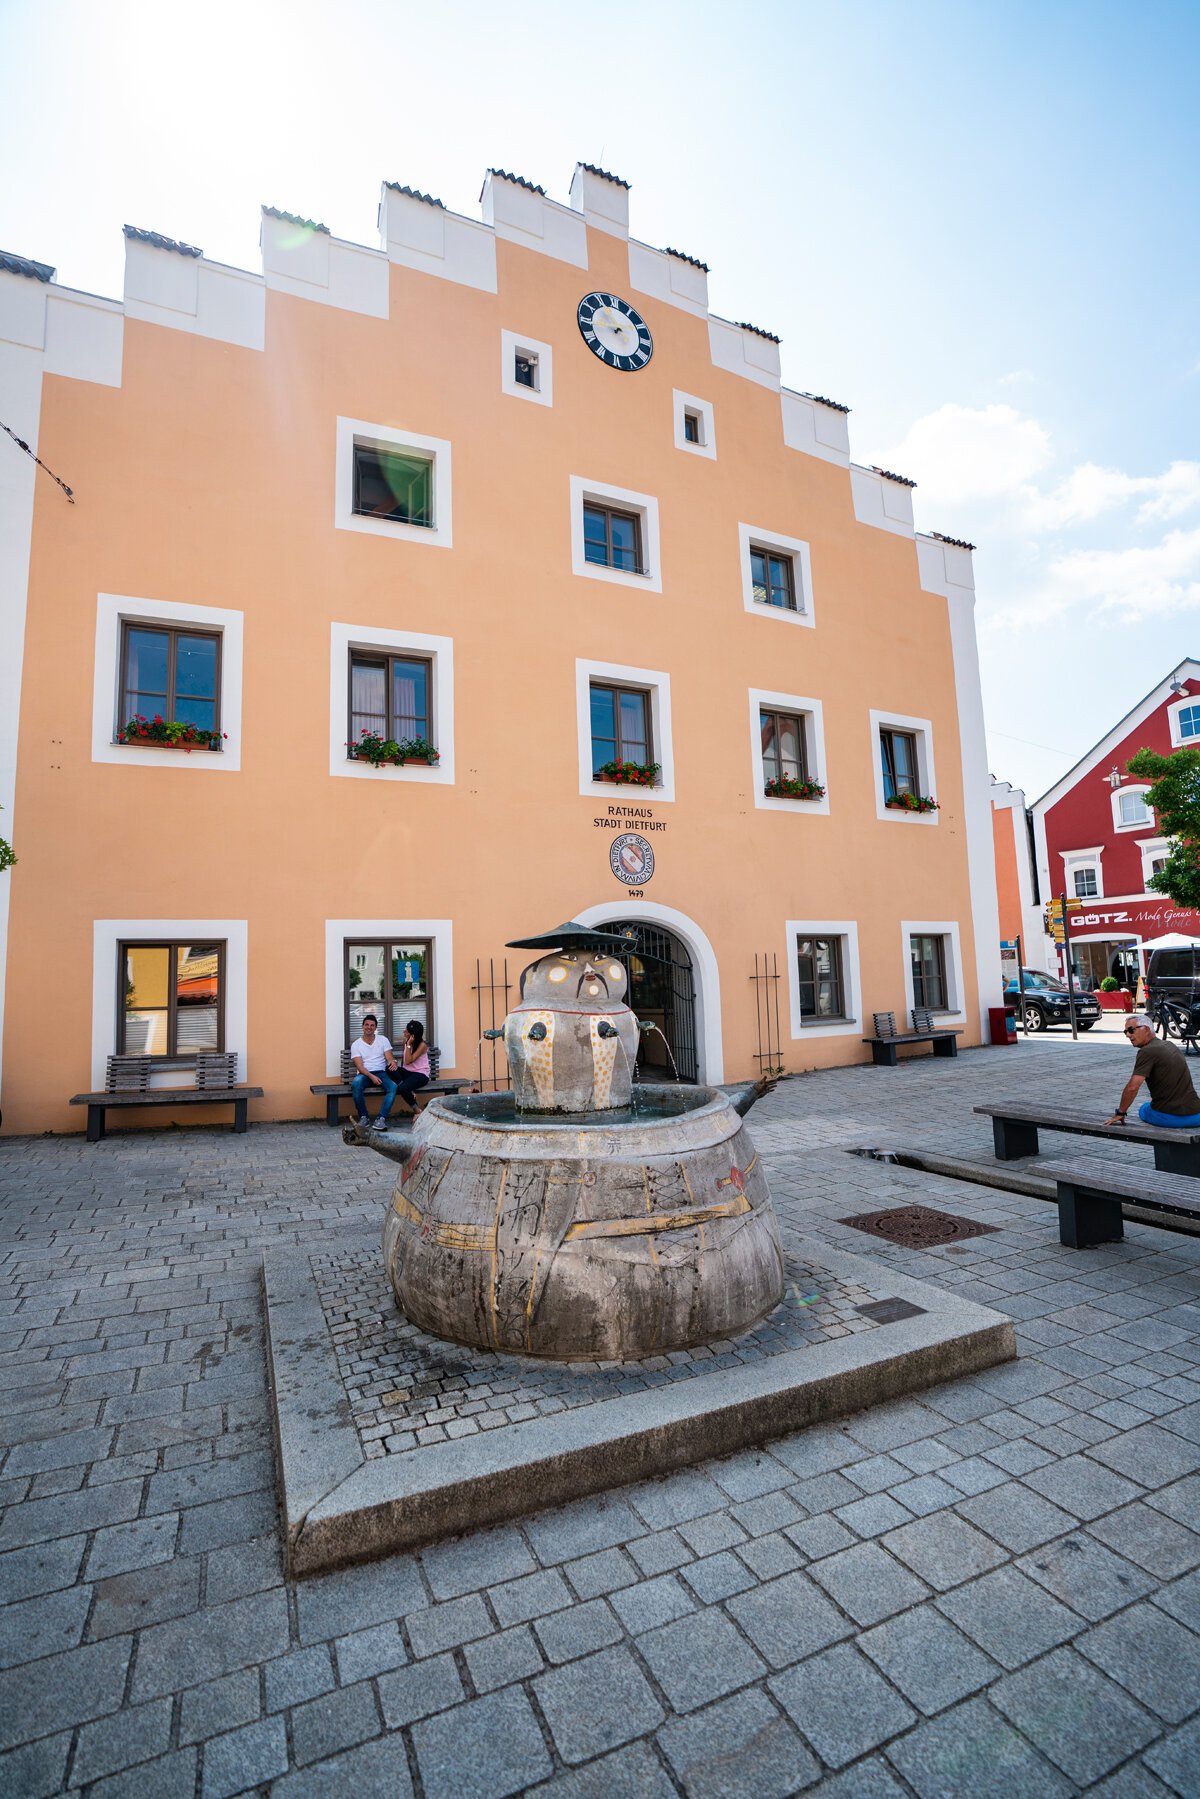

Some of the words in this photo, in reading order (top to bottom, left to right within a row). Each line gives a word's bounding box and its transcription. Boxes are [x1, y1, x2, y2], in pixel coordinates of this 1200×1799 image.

[607, 806, 653, 818] RATHAUS
[593, 818, 622, 829] STADT
[625, 820, 667, 832] DIETFURT
[628, 889, 644, 898] 1479
[1135, 906, 1162, 921] Mode
